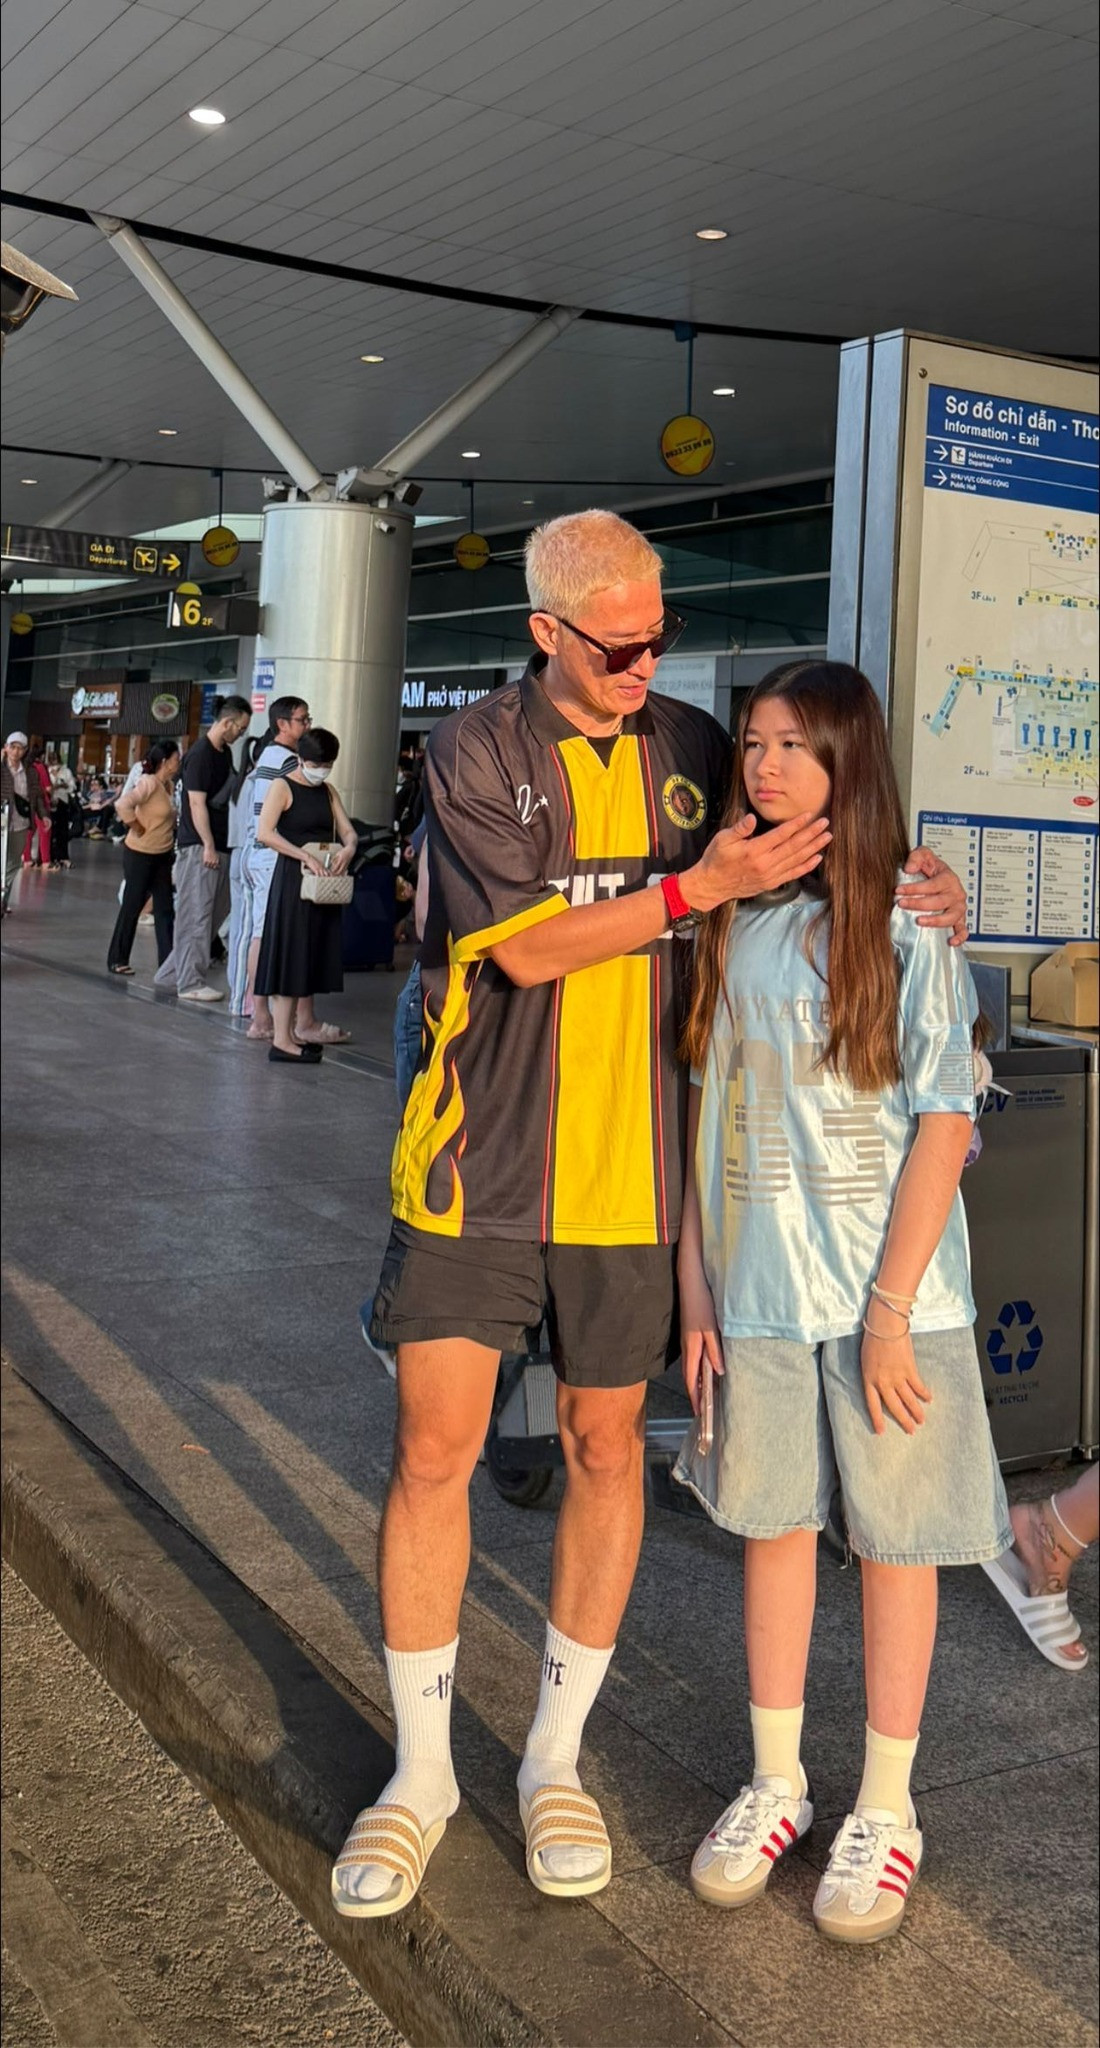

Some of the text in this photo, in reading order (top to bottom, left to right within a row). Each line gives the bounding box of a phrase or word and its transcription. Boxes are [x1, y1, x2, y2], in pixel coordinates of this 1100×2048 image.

[945, 395, 968, 416] Sơ
[972, 400, 994, 421] đồ
[998, 407, 1023, 426] chỉ
[1028, 410, 1057, 432] dẫn
[944, 419, 1008, 441] Information
[1018, 432, 1040, 447] Exit
[90, 543, 104, 553] GA
[89, 555, 128, 567] Departures
[971, 590, 982, 600] 3F
[183, 599, 214, 626] 6 2F
[427, 684, 448, 707] PHỞ
[448, 685, 467, 710] VIỆT
[963, 765, 974, 775] 2F
